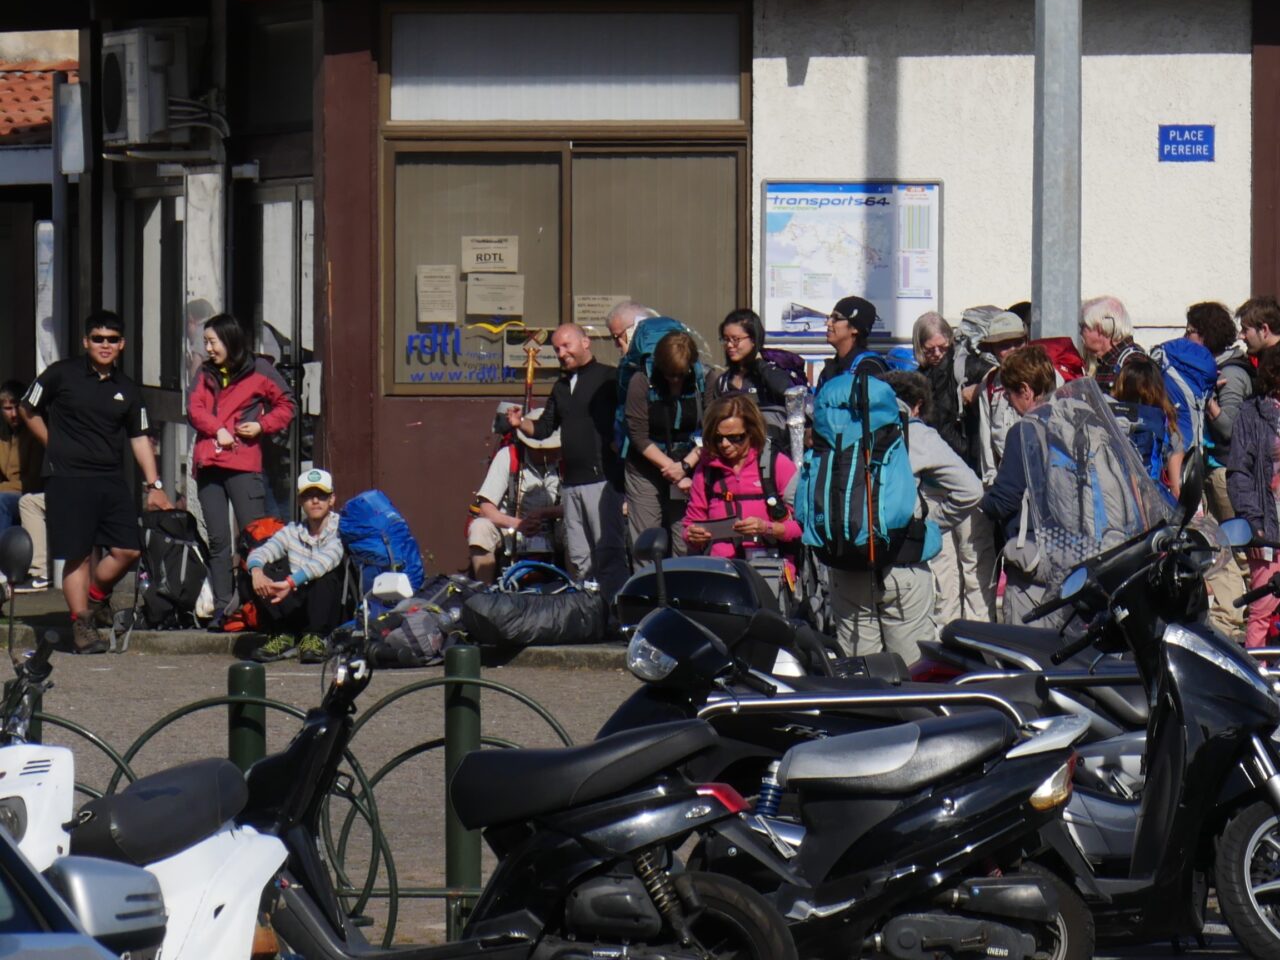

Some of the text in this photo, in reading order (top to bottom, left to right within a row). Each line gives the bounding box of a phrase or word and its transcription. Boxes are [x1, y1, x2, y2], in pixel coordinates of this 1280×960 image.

[1169, 130, 1204, 141] PLACE
[1164, 144, 1209, 155] PEREIRE
[475, 253, 504, 262] RDTL
